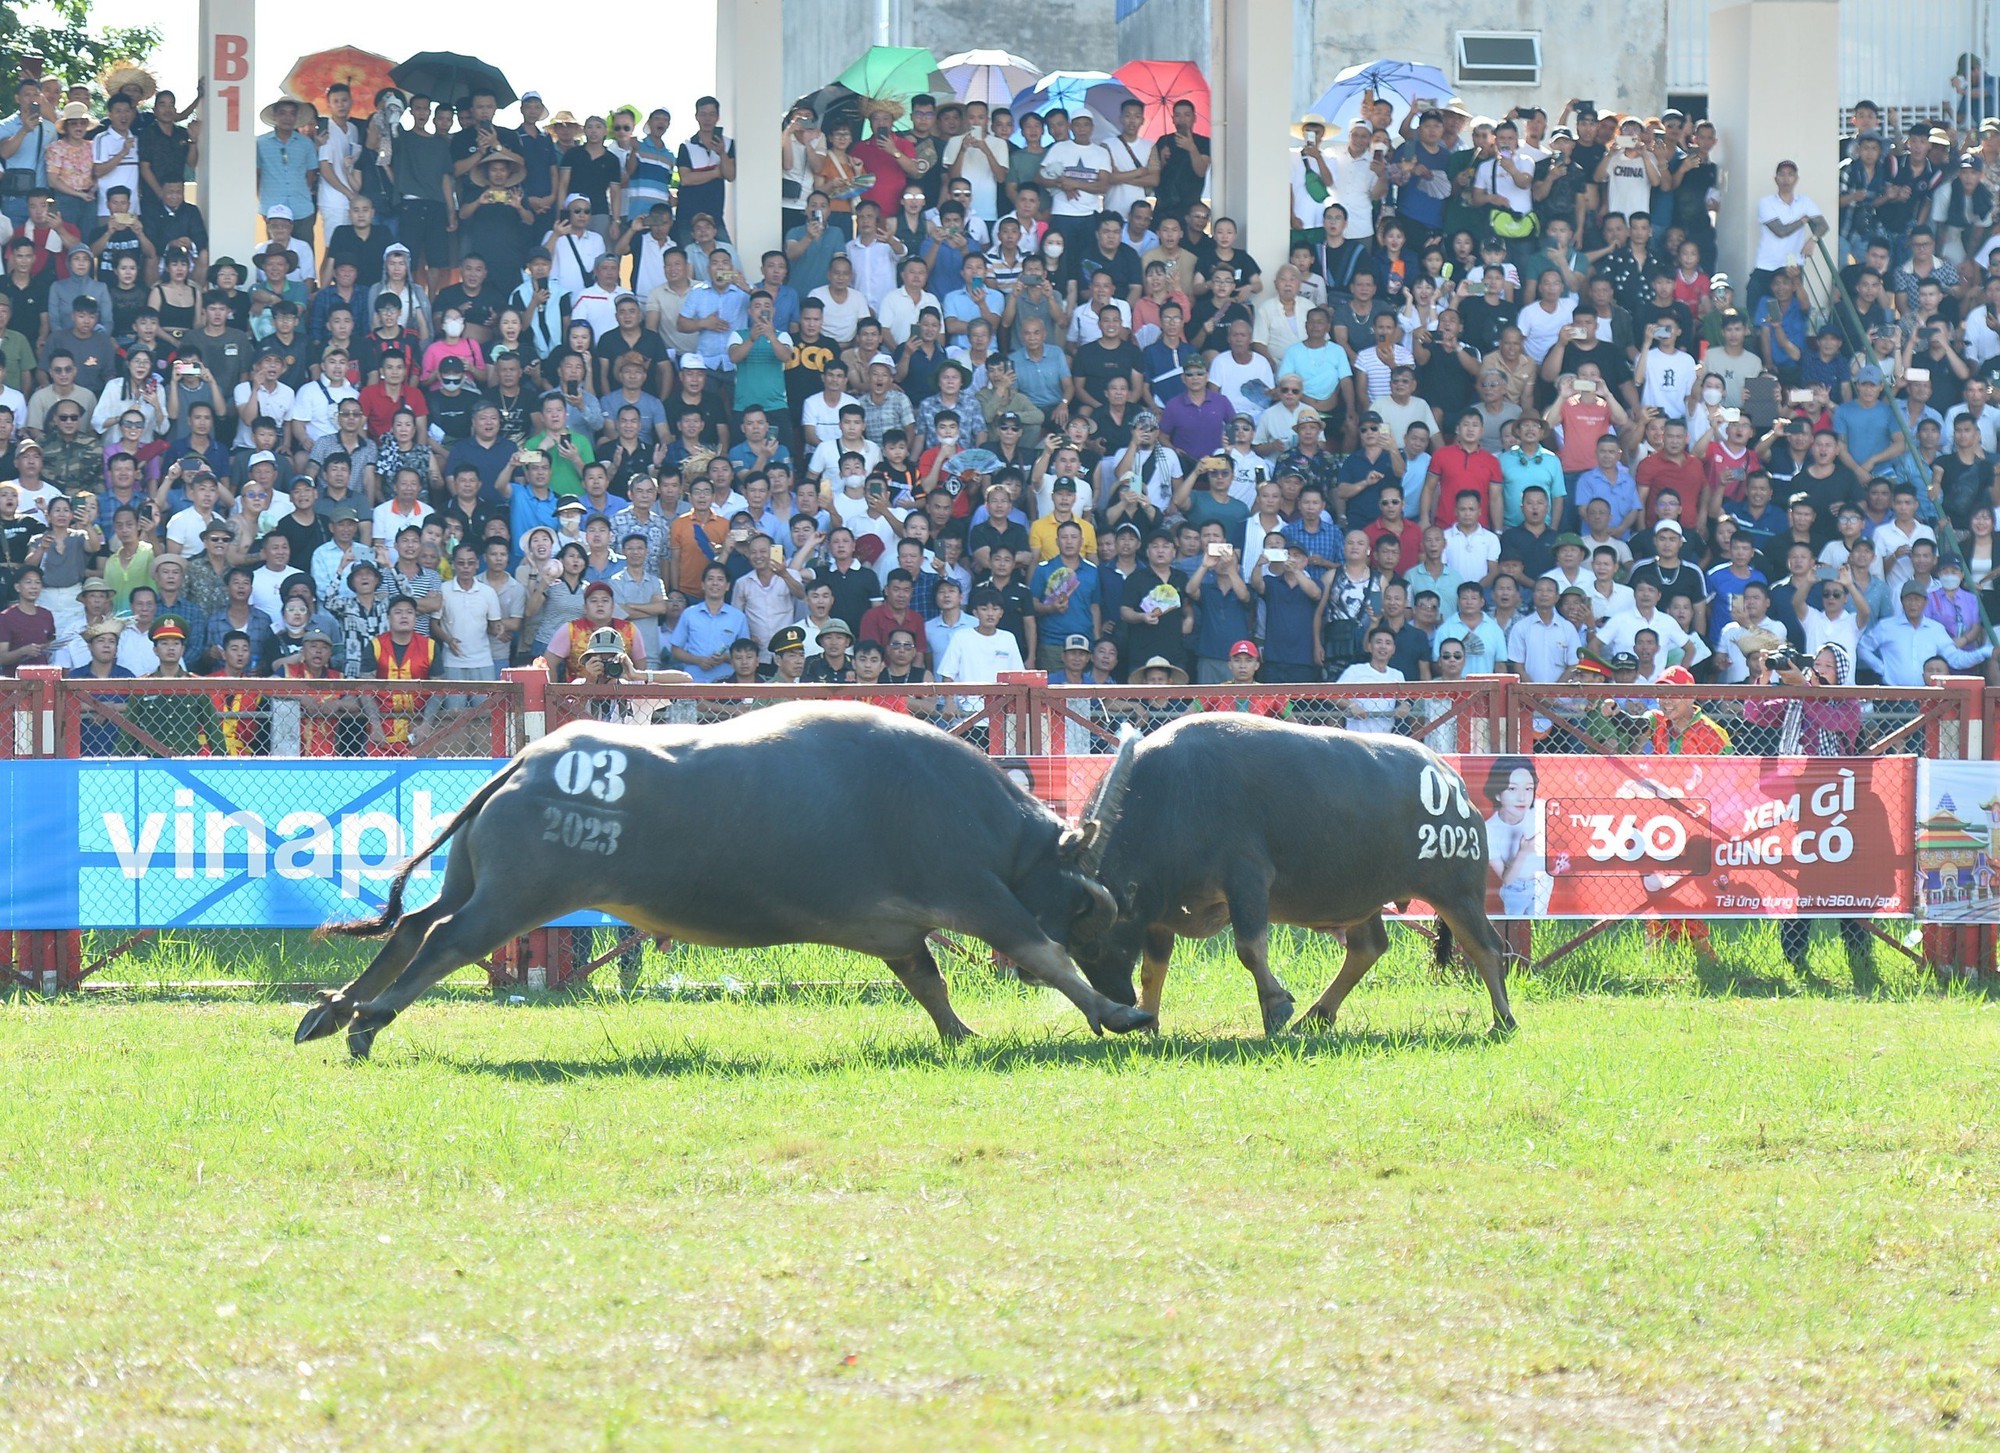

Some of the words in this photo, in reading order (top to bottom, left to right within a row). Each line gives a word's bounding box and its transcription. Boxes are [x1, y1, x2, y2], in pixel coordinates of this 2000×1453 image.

[214, 34, 249, 81] B
[217, 86, 240, 132] 1
[1613, 165, 1644, 178] CHINA
[554, 749, 628, 803] 03
[1742, 793, 1801, 832] XEM
[1811, 767, 1855, 817] GÌ
[542, 806, 622, 856] 2023
[1418, 823, 1481, 860] 2023
[1714, 834, 1783, 867] CŨNG
[1791, 813, 1854, 864] CÓ
[1714, 895, 1735, 907] Tải
[1736, 894, 1760, 909] ứng
[1761, 895, 1793, 910] dụng
[1796, 895, 1814, 909] tại:
[1816, 895, 1901, 909] tv360.vn/app
